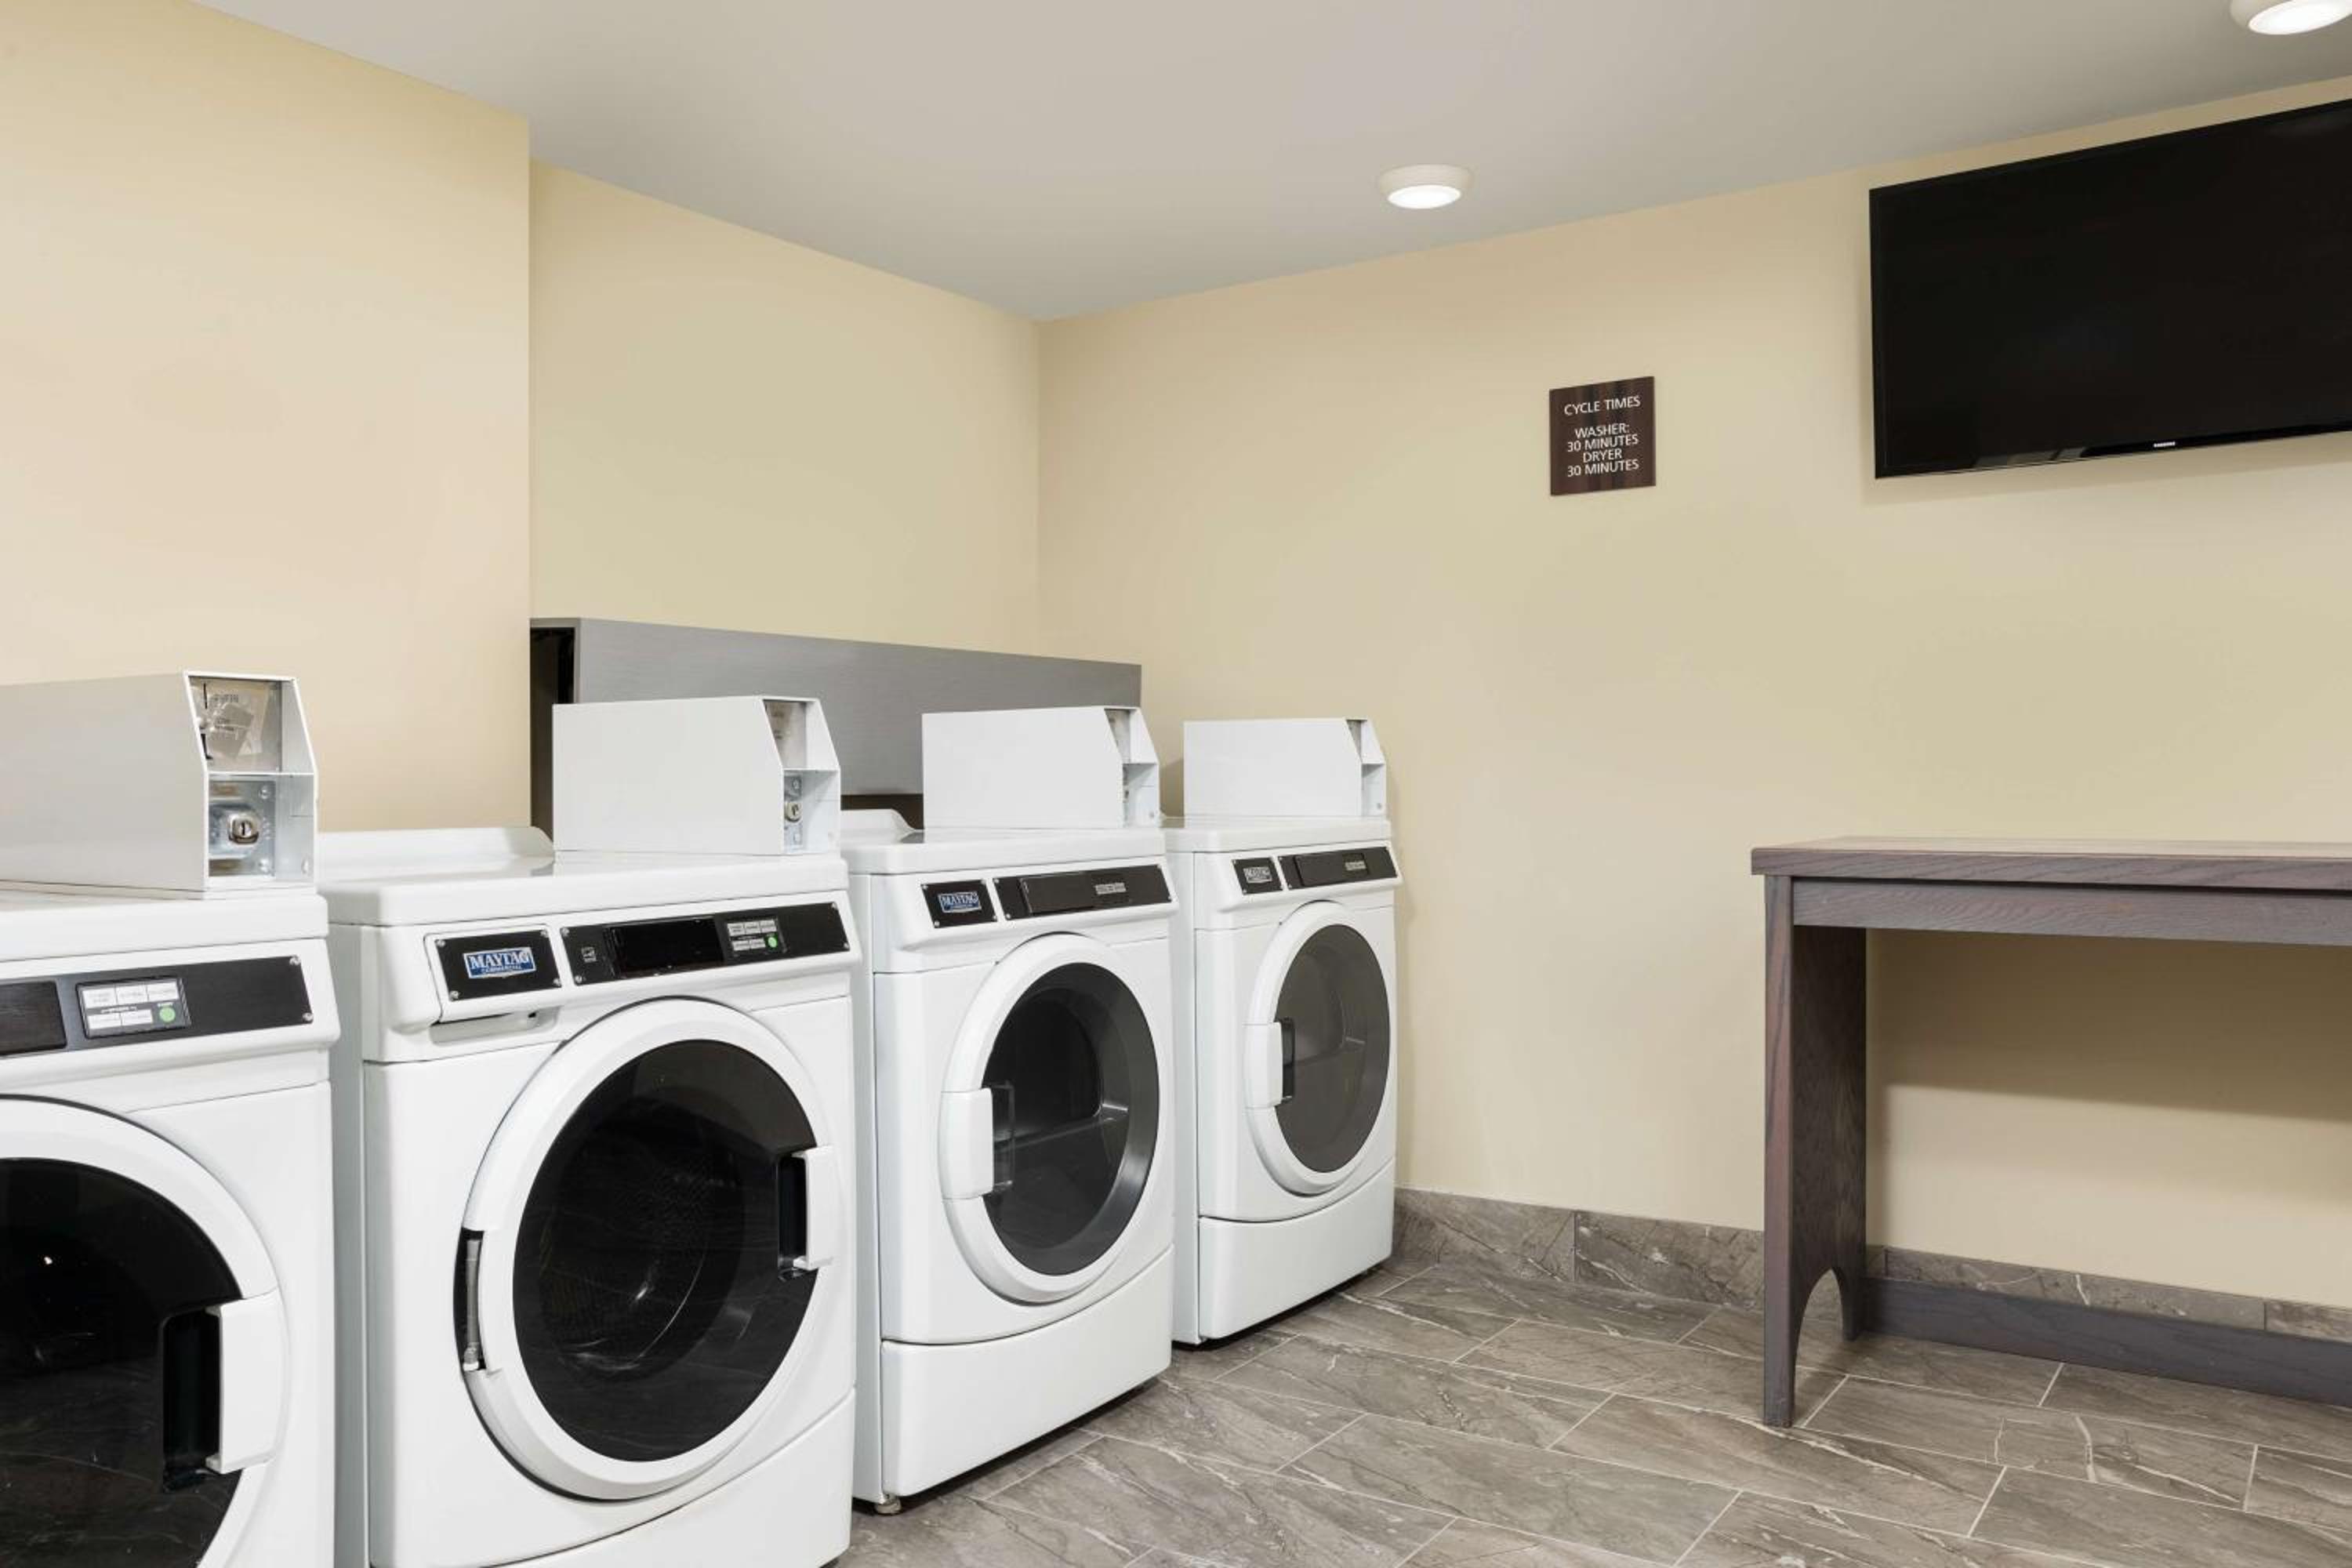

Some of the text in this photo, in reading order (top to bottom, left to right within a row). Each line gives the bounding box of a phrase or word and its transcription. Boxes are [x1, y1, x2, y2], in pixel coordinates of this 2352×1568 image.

[1564, 395, 1641, 416] CYCLE TIMES
[1574, 423, 1630, 438] WASHER:
[1567, 434, 1639, 452] 30 MINUTES
[1583, 448, 1622, 463] DRYER
[1567, 459, 1639, 477] 30 MINUTES
[469, 951, 529, 969] MAYTAG
